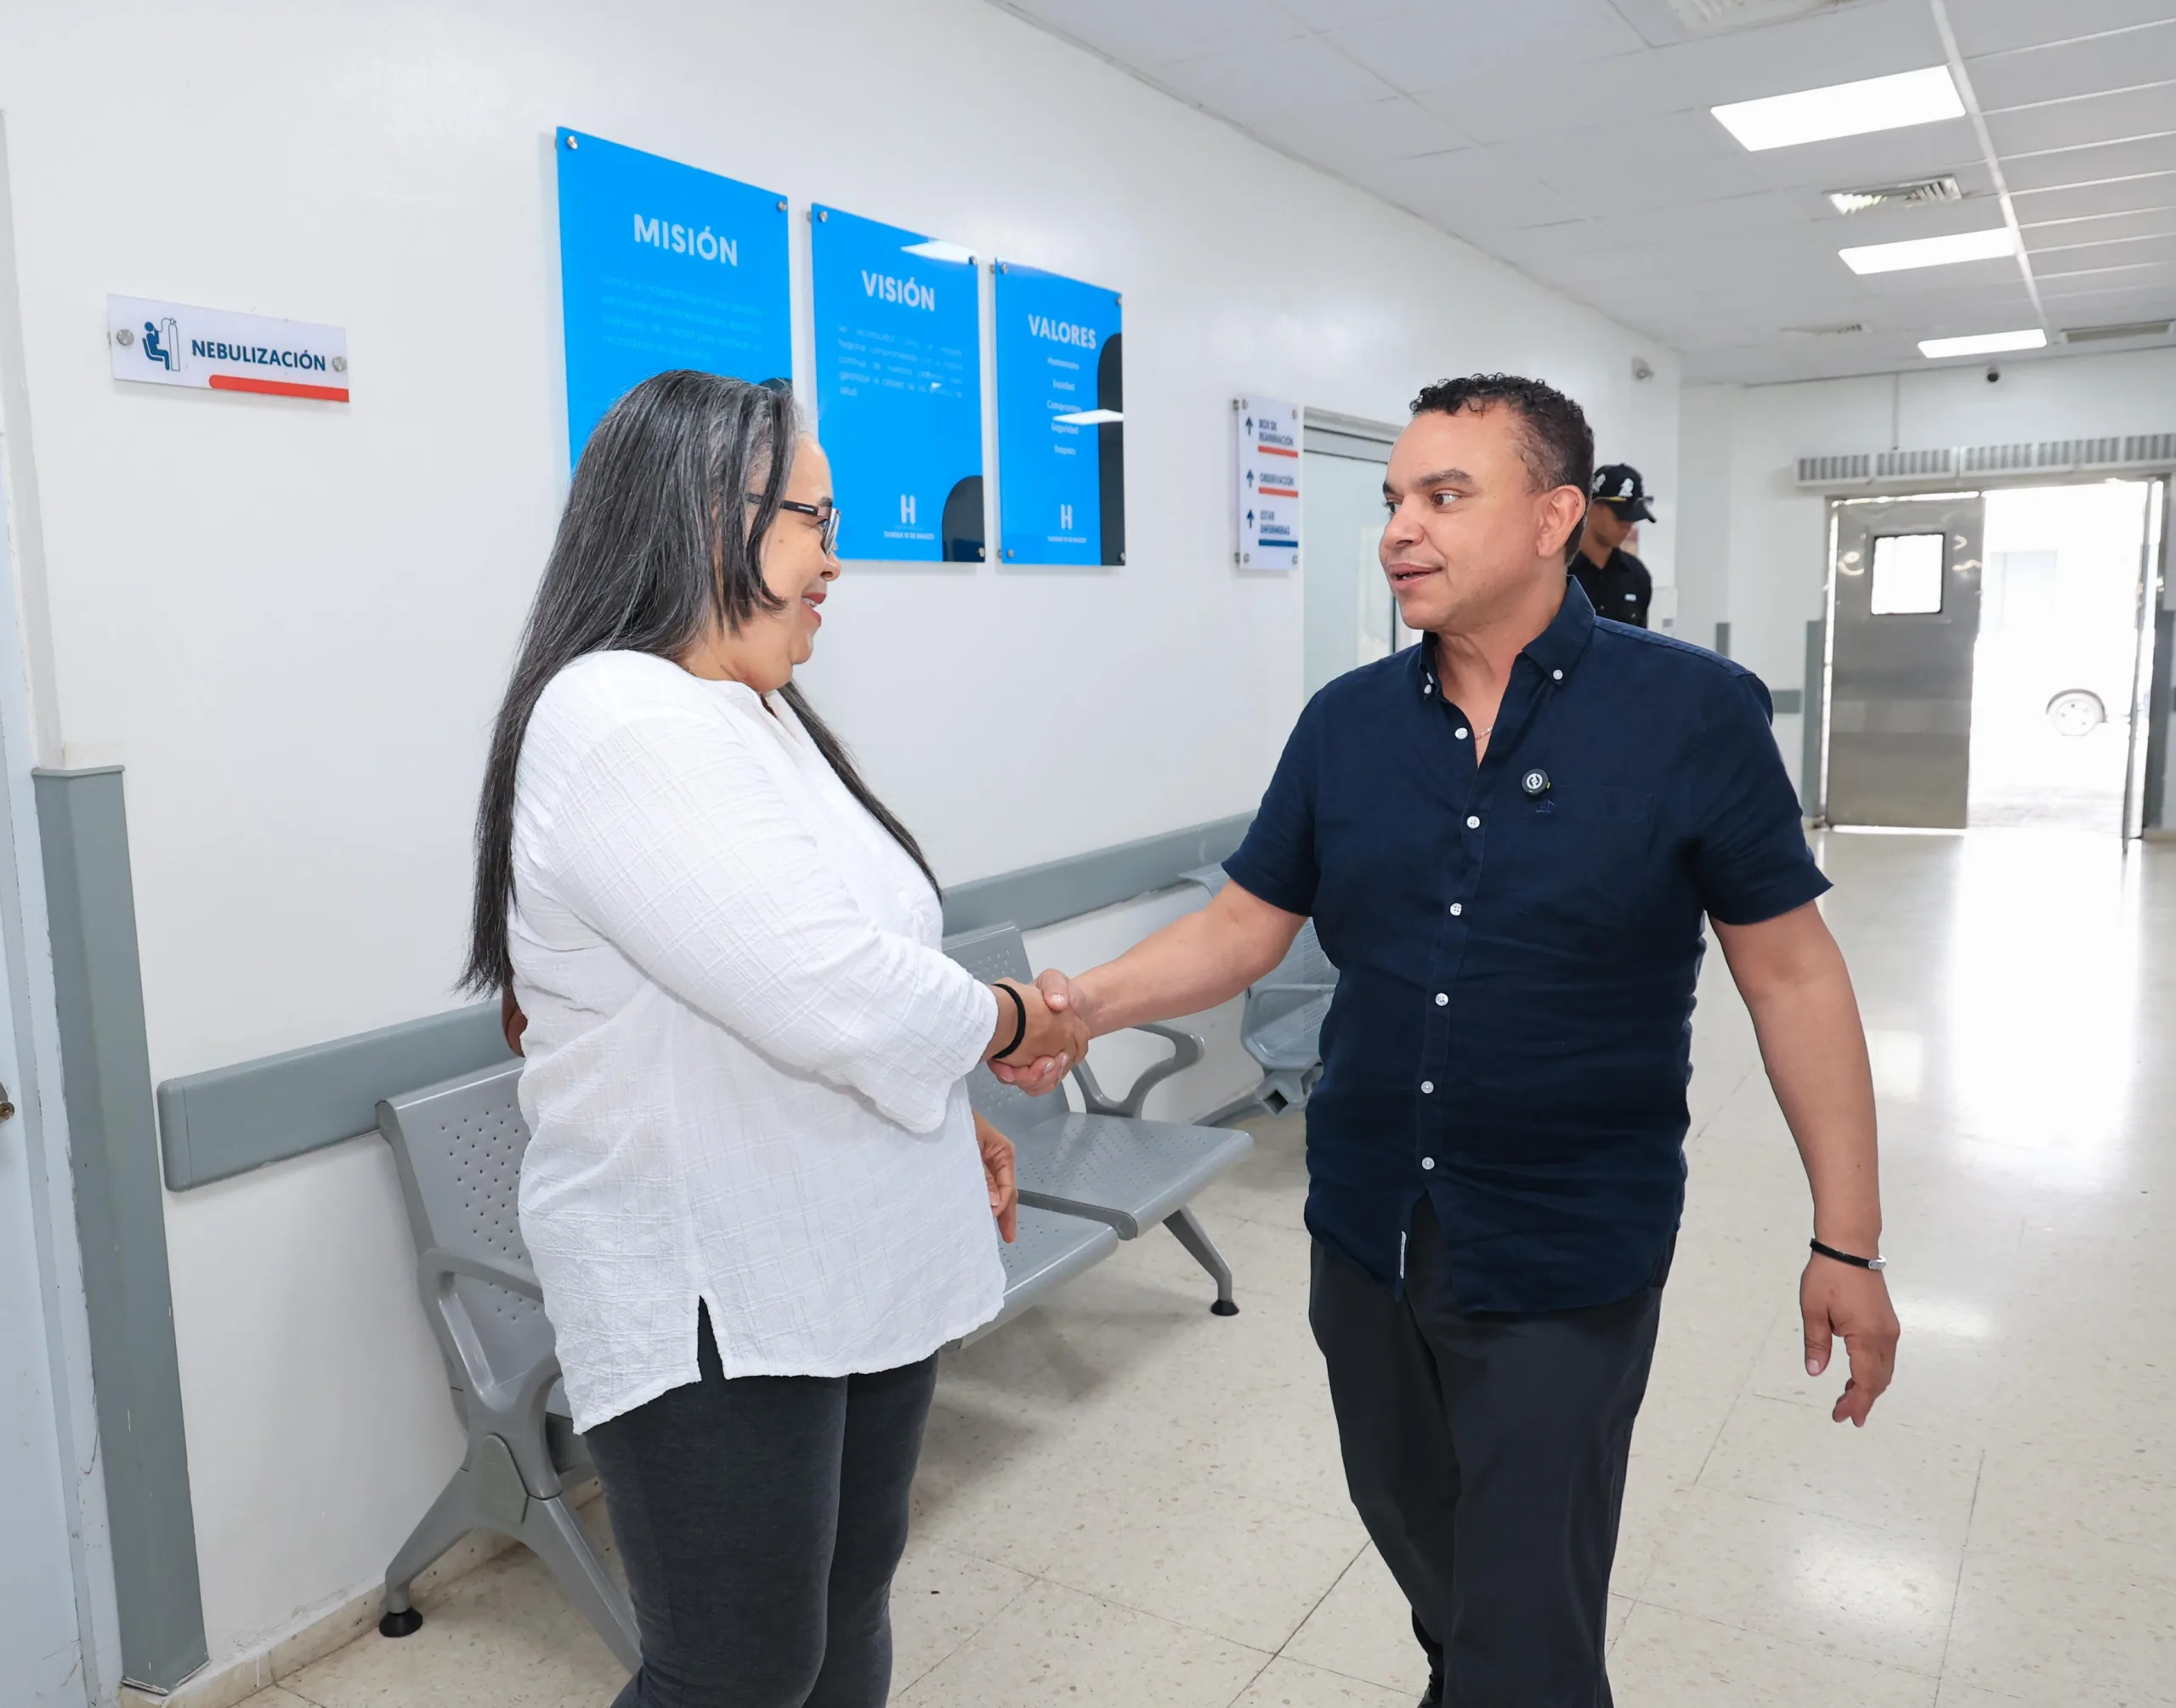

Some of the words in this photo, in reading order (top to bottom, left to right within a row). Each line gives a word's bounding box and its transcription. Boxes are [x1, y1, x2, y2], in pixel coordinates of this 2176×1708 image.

[634, 212, 738, 267] MISIÓN
[861, 269, 935, 312] VISIÓN
[1028, 313, 1096, 350] VALORES
[191, 339, 326, 371] NEBULIZACIÓN
[900, 494, 916, 524] H
[1060, 503, 1073, 530] H
